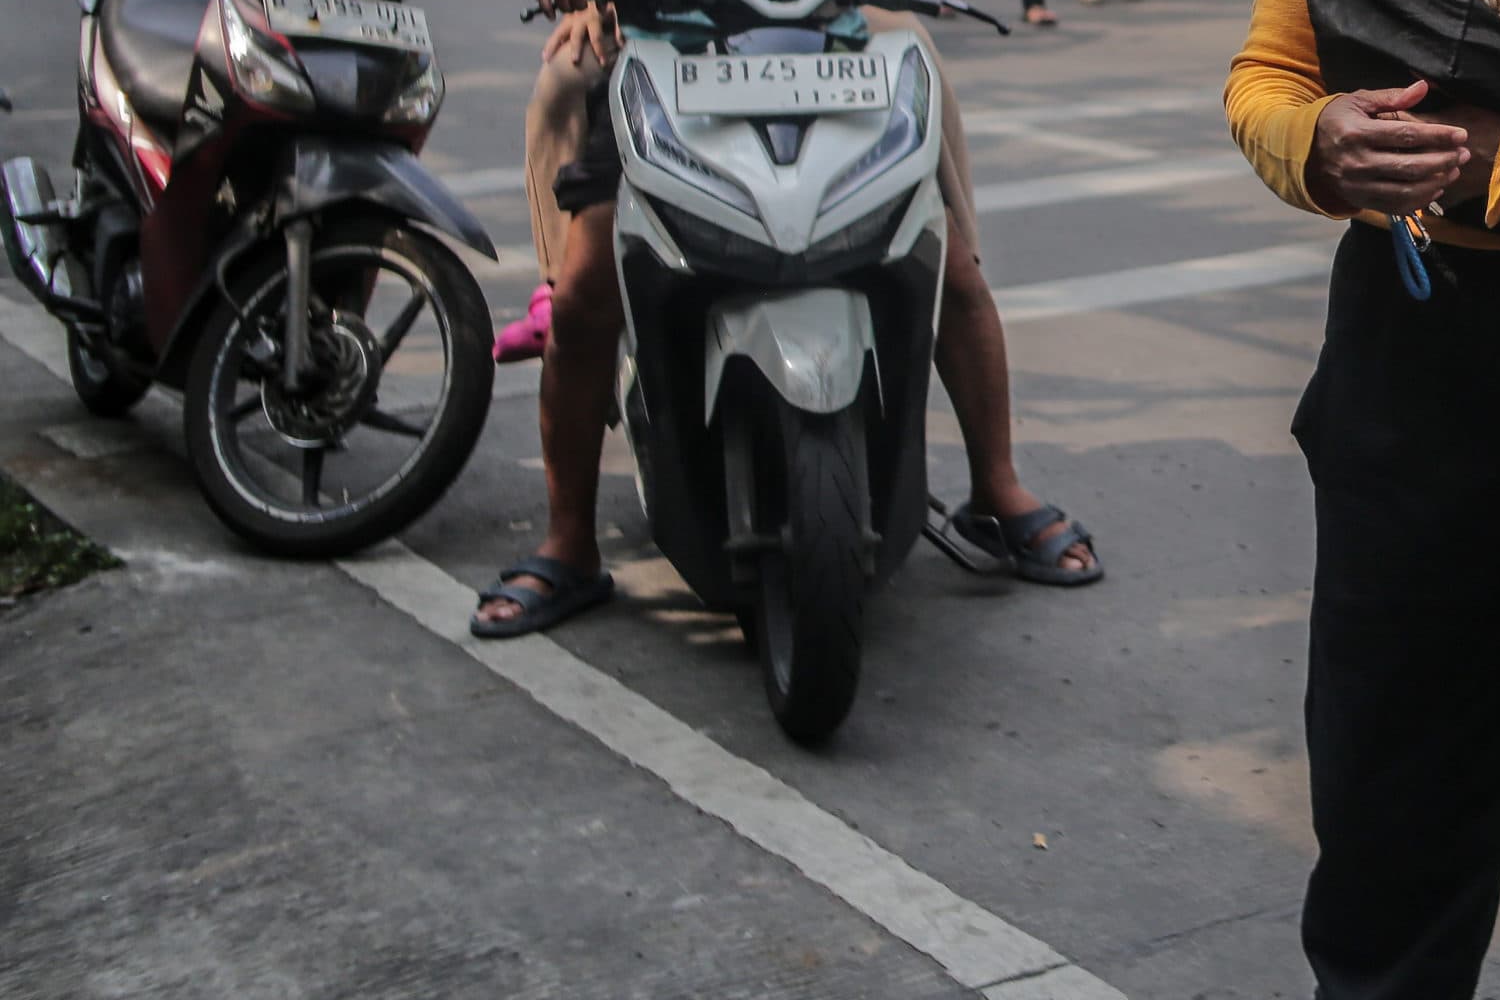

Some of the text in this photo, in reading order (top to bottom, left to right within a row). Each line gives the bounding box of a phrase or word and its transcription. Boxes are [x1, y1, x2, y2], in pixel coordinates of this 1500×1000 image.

[680, 56, 877, 85] B 3145 URU
